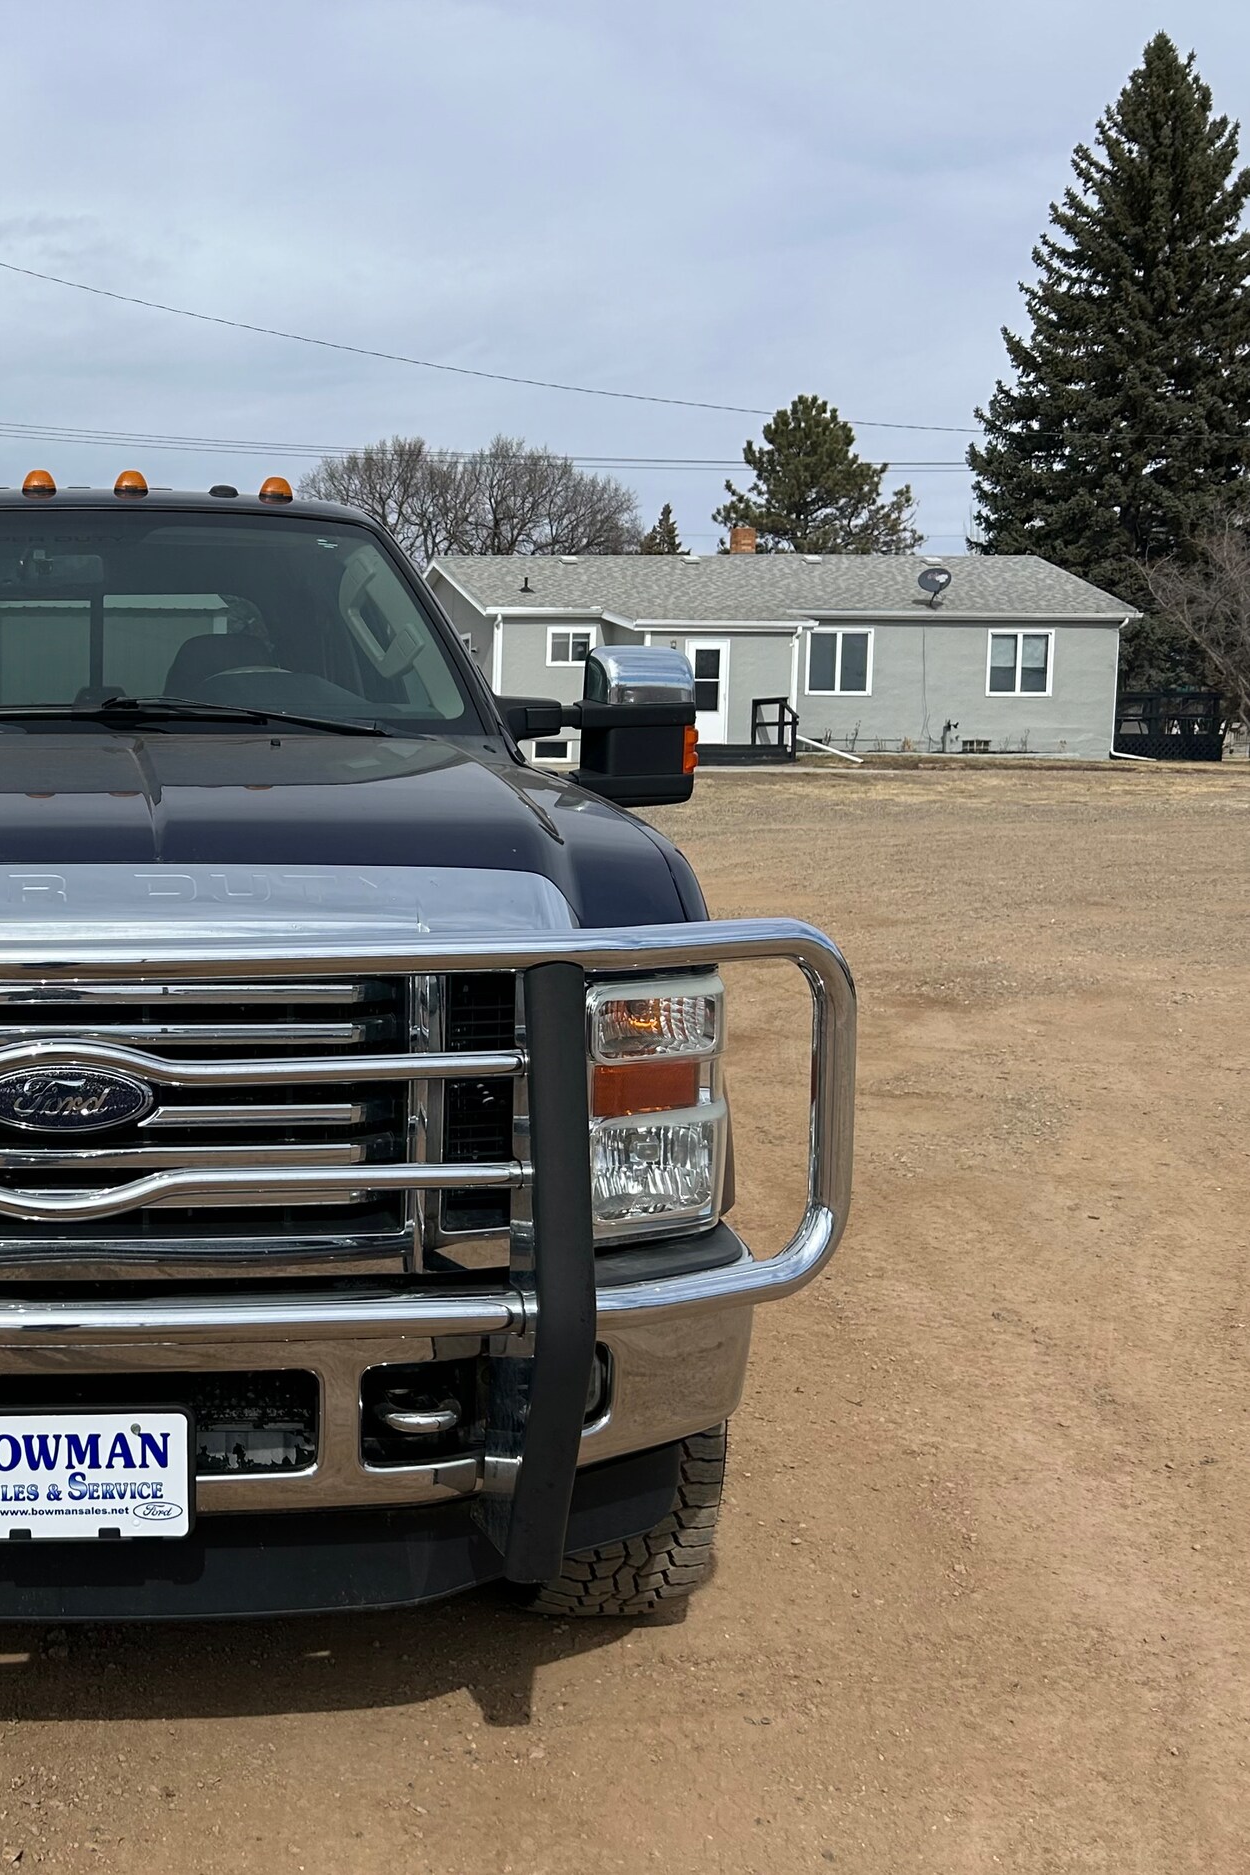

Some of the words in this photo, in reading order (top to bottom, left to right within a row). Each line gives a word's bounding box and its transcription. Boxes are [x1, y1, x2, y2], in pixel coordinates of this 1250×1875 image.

[54, 535, 126, 544] DUTY
[13, 1076, 112, 1117] Ford
[46, 1483, 63, 1501] &
[0, 1505, 130, 1517] www.bowmansales.net
[142, 1503, 173, 1517] Ford
